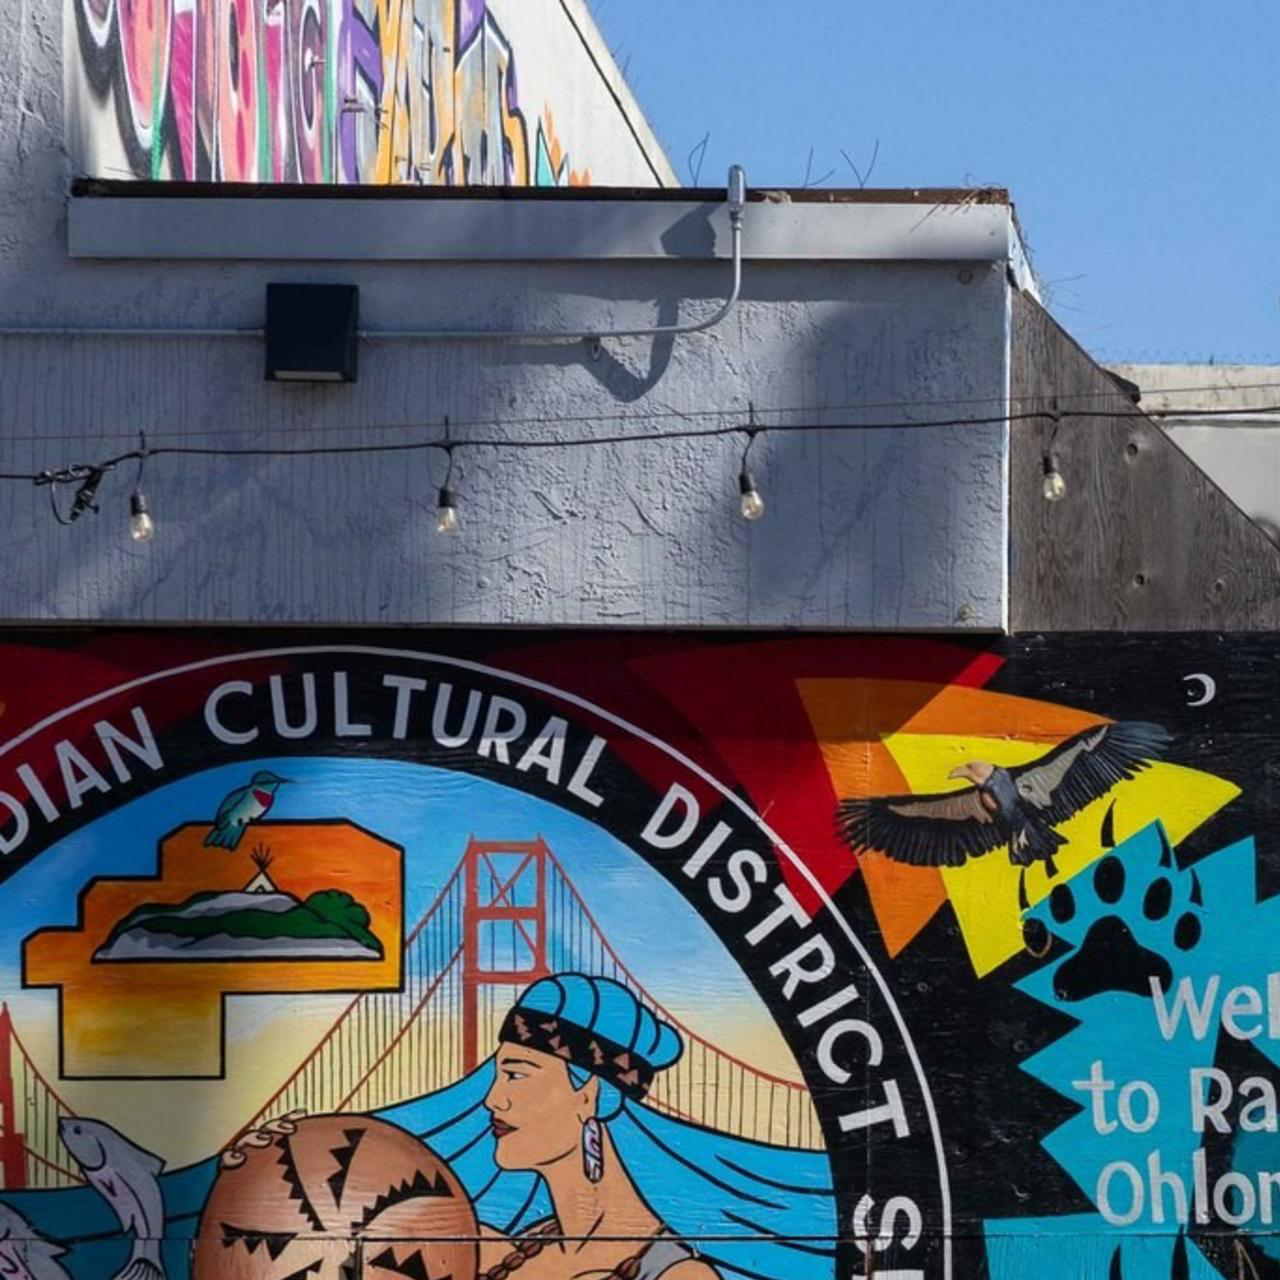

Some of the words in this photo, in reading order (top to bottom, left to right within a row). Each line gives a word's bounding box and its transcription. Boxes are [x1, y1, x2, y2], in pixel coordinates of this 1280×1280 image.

[203, 671, 606, 808] CULTURAL
[640, 782, 912, 1139] DISTRICT
[1072, 1061, 1159, 1134] to
